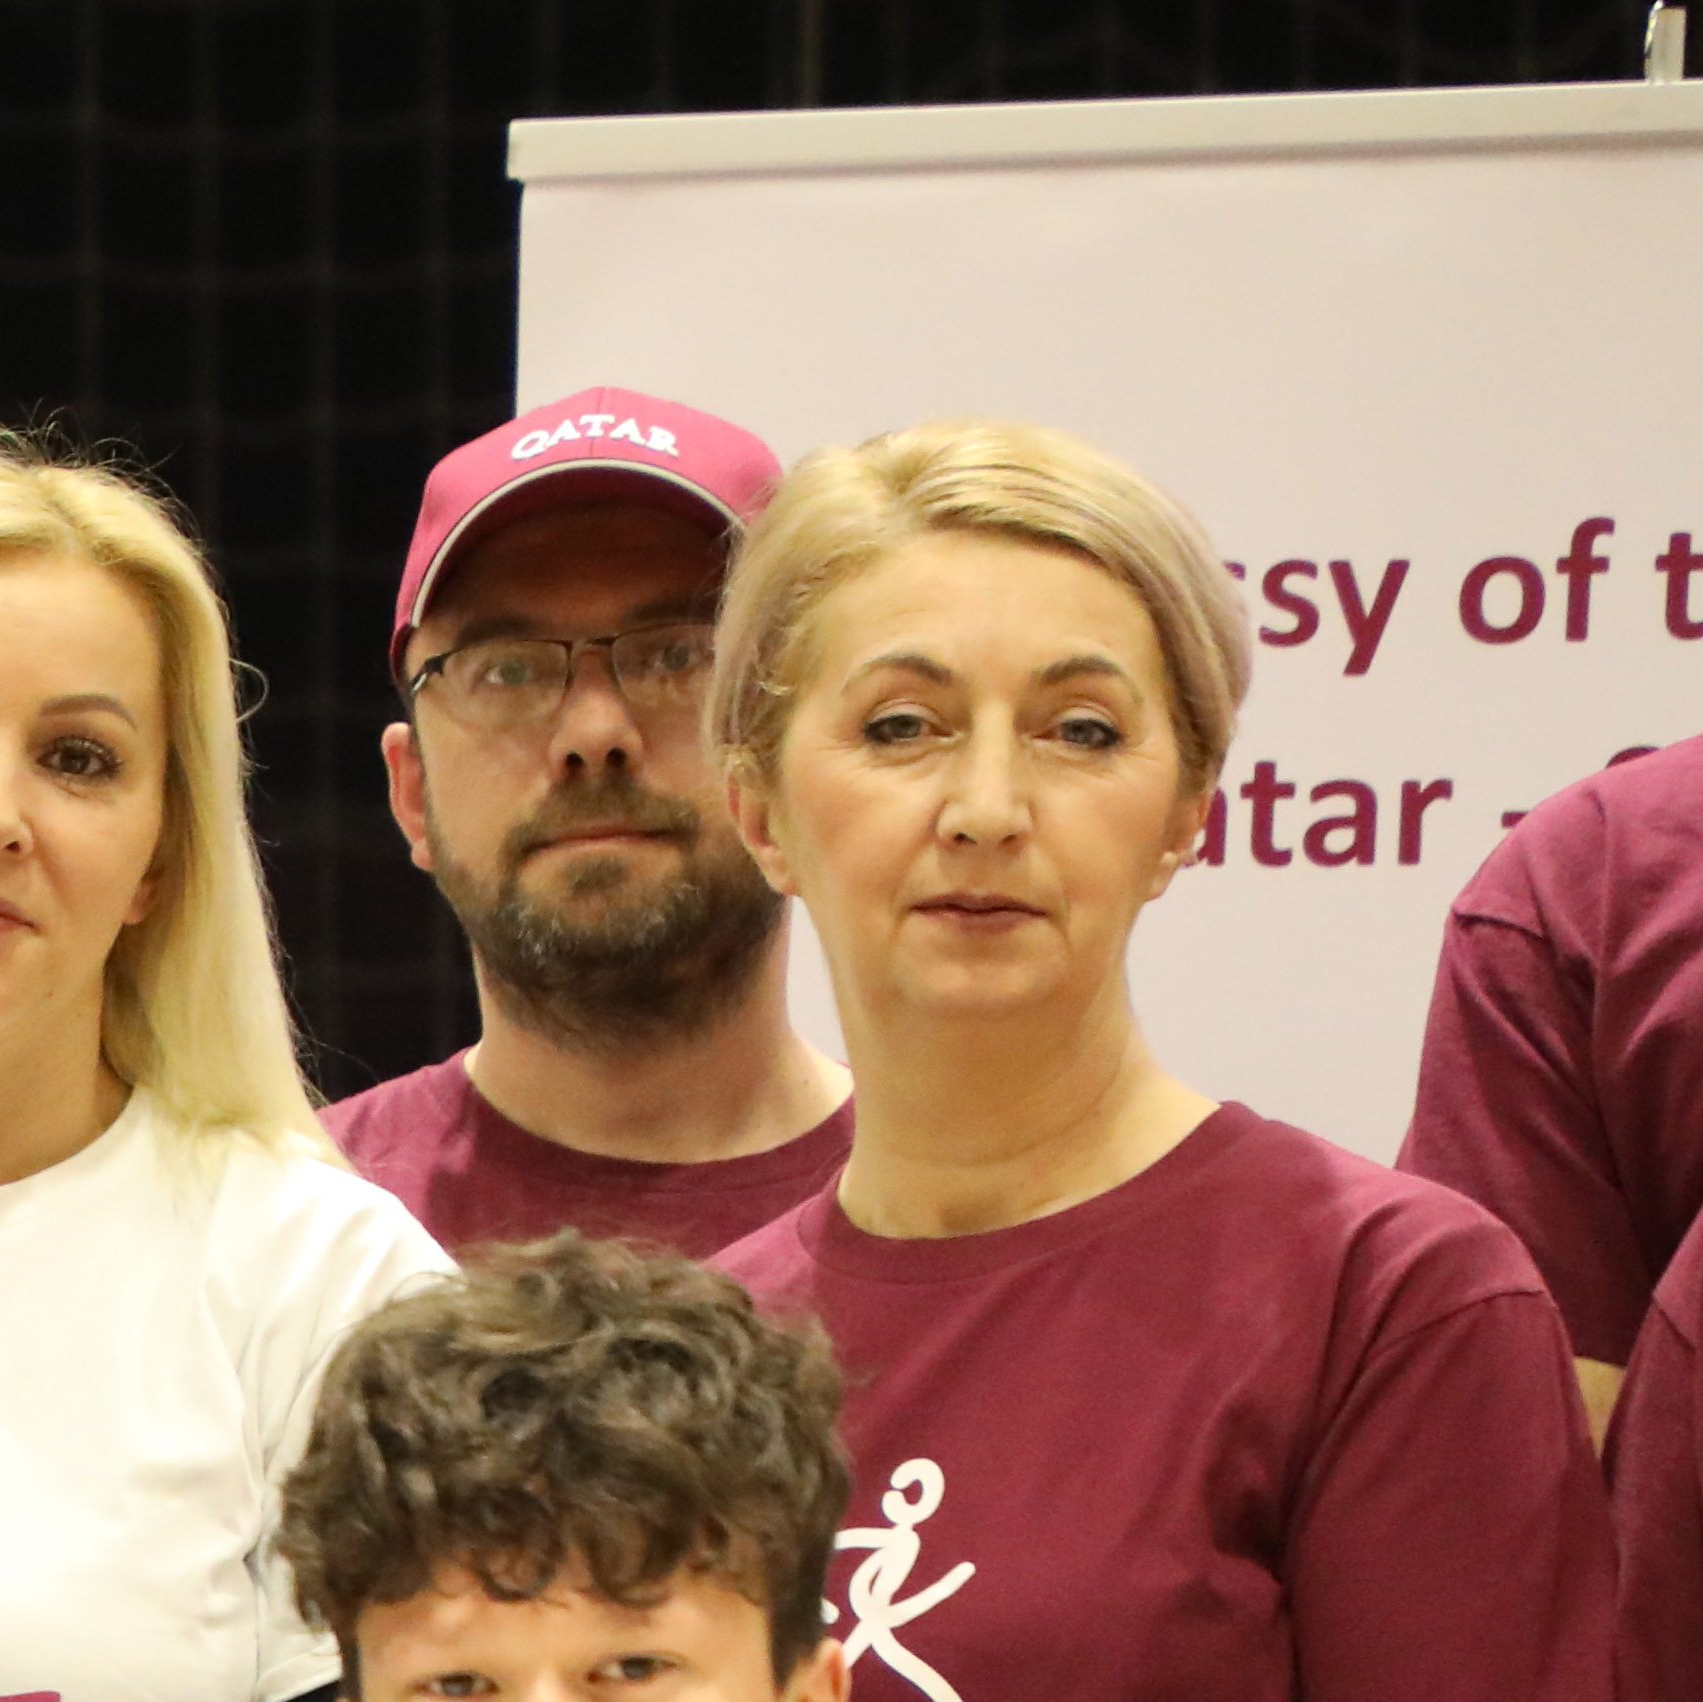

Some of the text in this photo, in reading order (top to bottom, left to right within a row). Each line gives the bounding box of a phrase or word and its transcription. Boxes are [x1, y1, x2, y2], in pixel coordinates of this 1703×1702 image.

[511, 414, 679, 459] QATAR
[1225, 558, 1410, 676] sy
[1459, 516, 1615, 645] of
